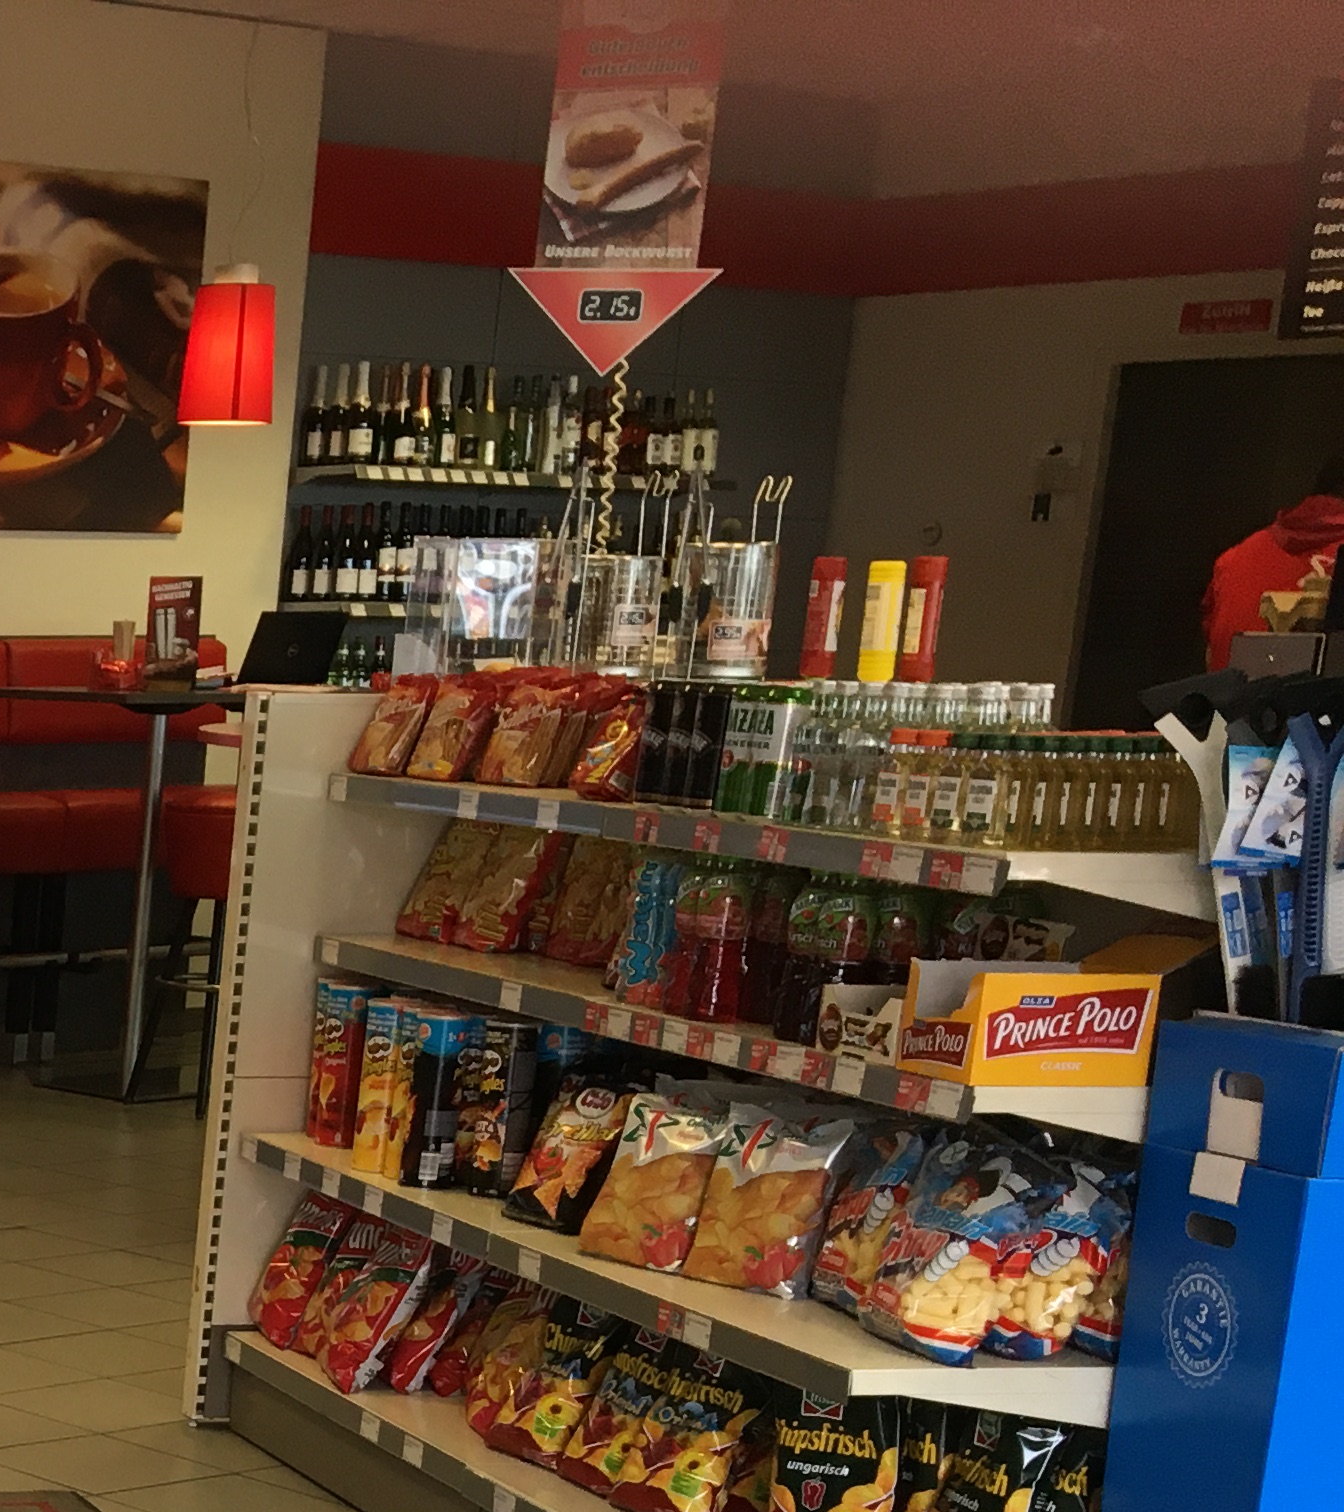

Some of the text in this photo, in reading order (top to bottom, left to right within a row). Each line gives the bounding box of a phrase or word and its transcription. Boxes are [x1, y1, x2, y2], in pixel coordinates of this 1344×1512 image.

[992, 995, 1137, 1050] PRINCE POLO
[935, 1024, 964, 1051] POLO
[1040, 1060, 1083, 1071] CLASSIC
[1196, 1303, 1208, 1324] 3
[786, 1459, 850, 1478] ungarisch
